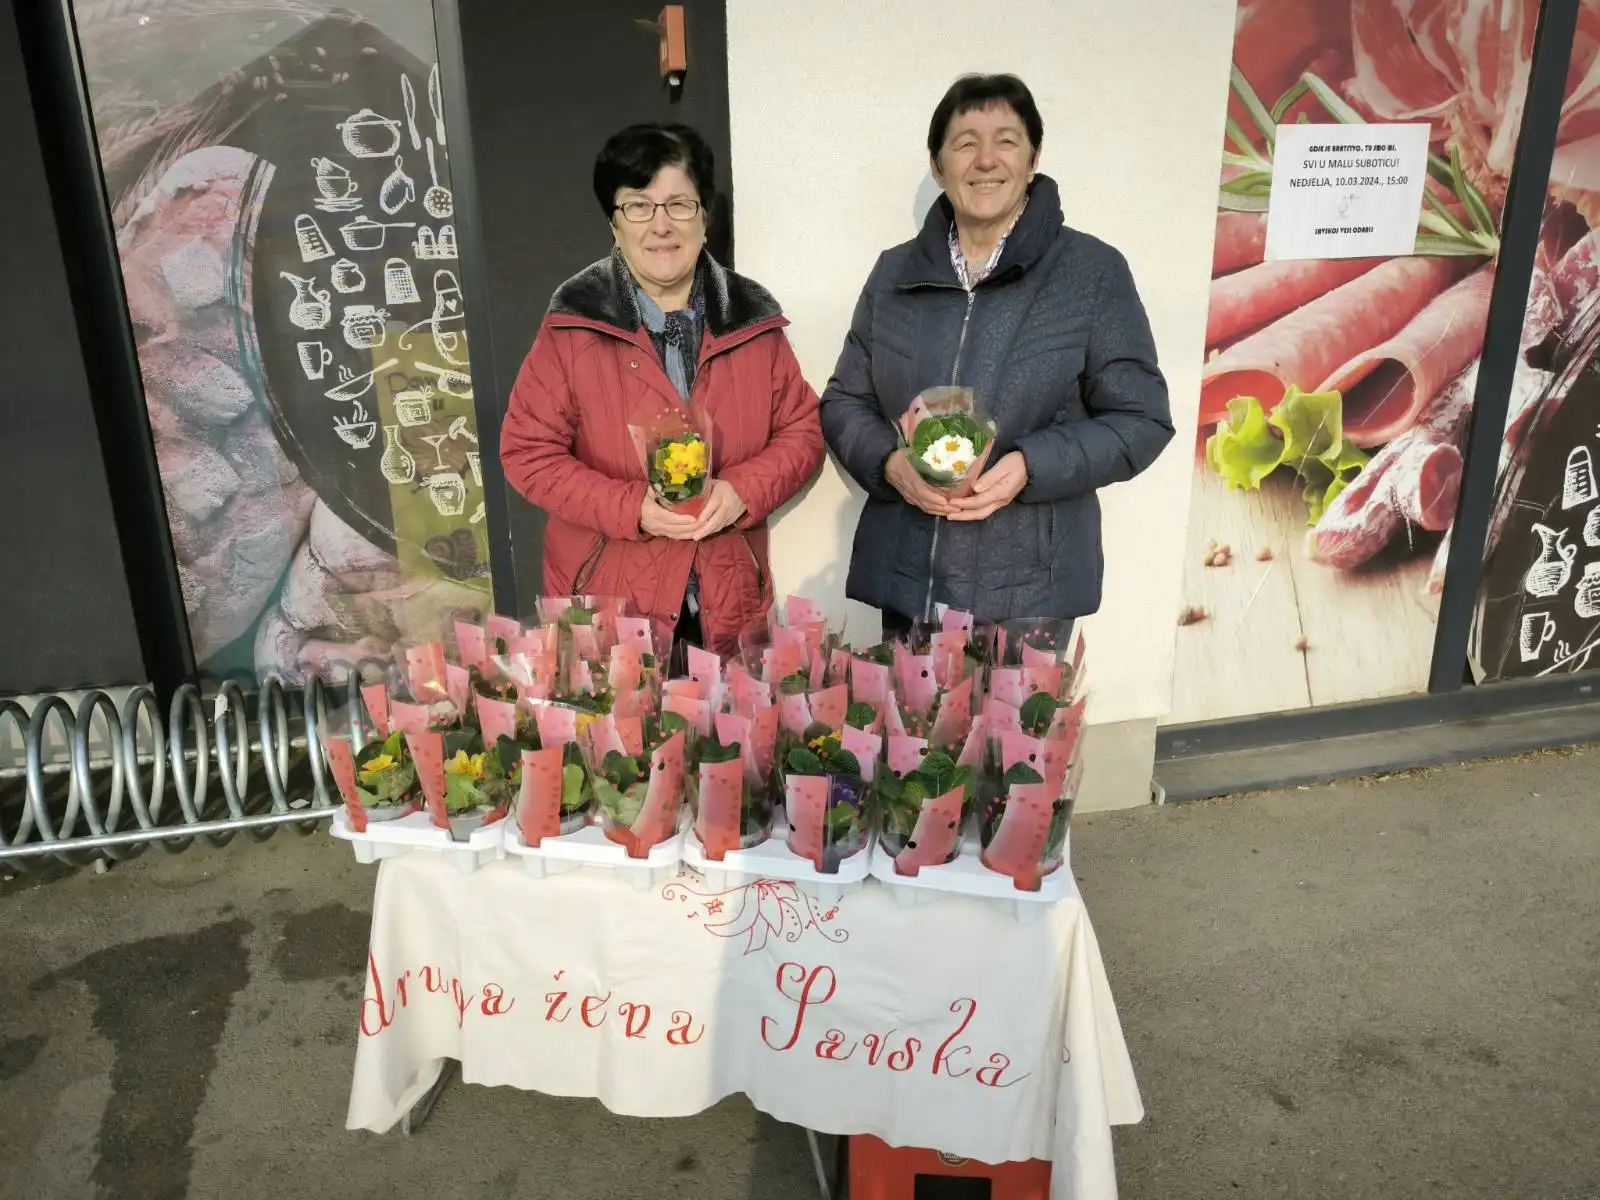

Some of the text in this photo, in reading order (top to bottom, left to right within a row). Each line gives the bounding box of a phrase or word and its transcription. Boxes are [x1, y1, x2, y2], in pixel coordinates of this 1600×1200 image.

[1303, 160, 1317, 168] SVI
[1319, 160, 1325, 168] U
[1328, 159, 1353, 168] MALU
[1289, 176, 1408, 187] NEDJELJA, 10.03.2024., 15:00
[545, 969, 705, 1046] žena
[761, 962, 1031, 1088] Savska
